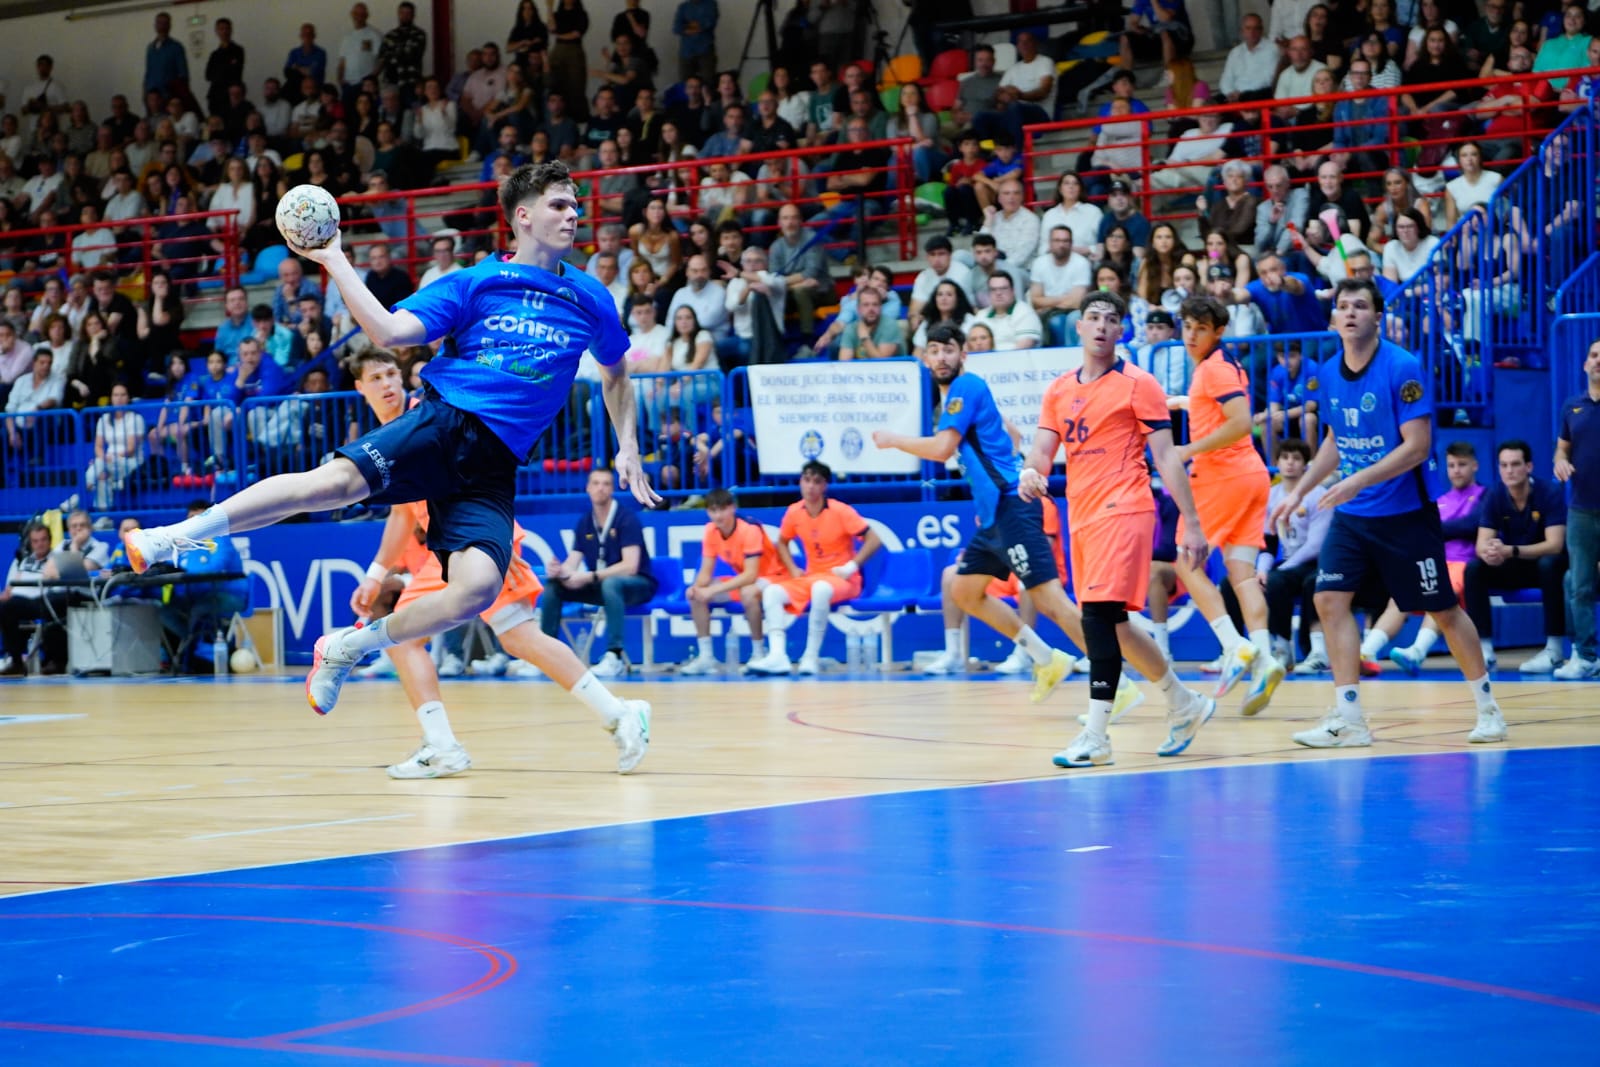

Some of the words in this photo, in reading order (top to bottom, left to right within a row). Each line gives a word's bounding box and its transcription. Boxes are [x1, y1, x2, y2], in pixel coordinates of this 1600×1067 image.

[760, 375, 799, 387] DONDE
[801, 373, 865, 388] JUGUEMOS
[867, 372, 908, 385] SUENA
[757, 393, 771, 405] EL
[778, 411, 829, 424] SIEMPRE
[1341, 407, 1360, 428] 19
[1063, 417, 1089, 443] 26
[1007, 543, 1029, 566] 29
[1415, 557, 1439, 580] 19
